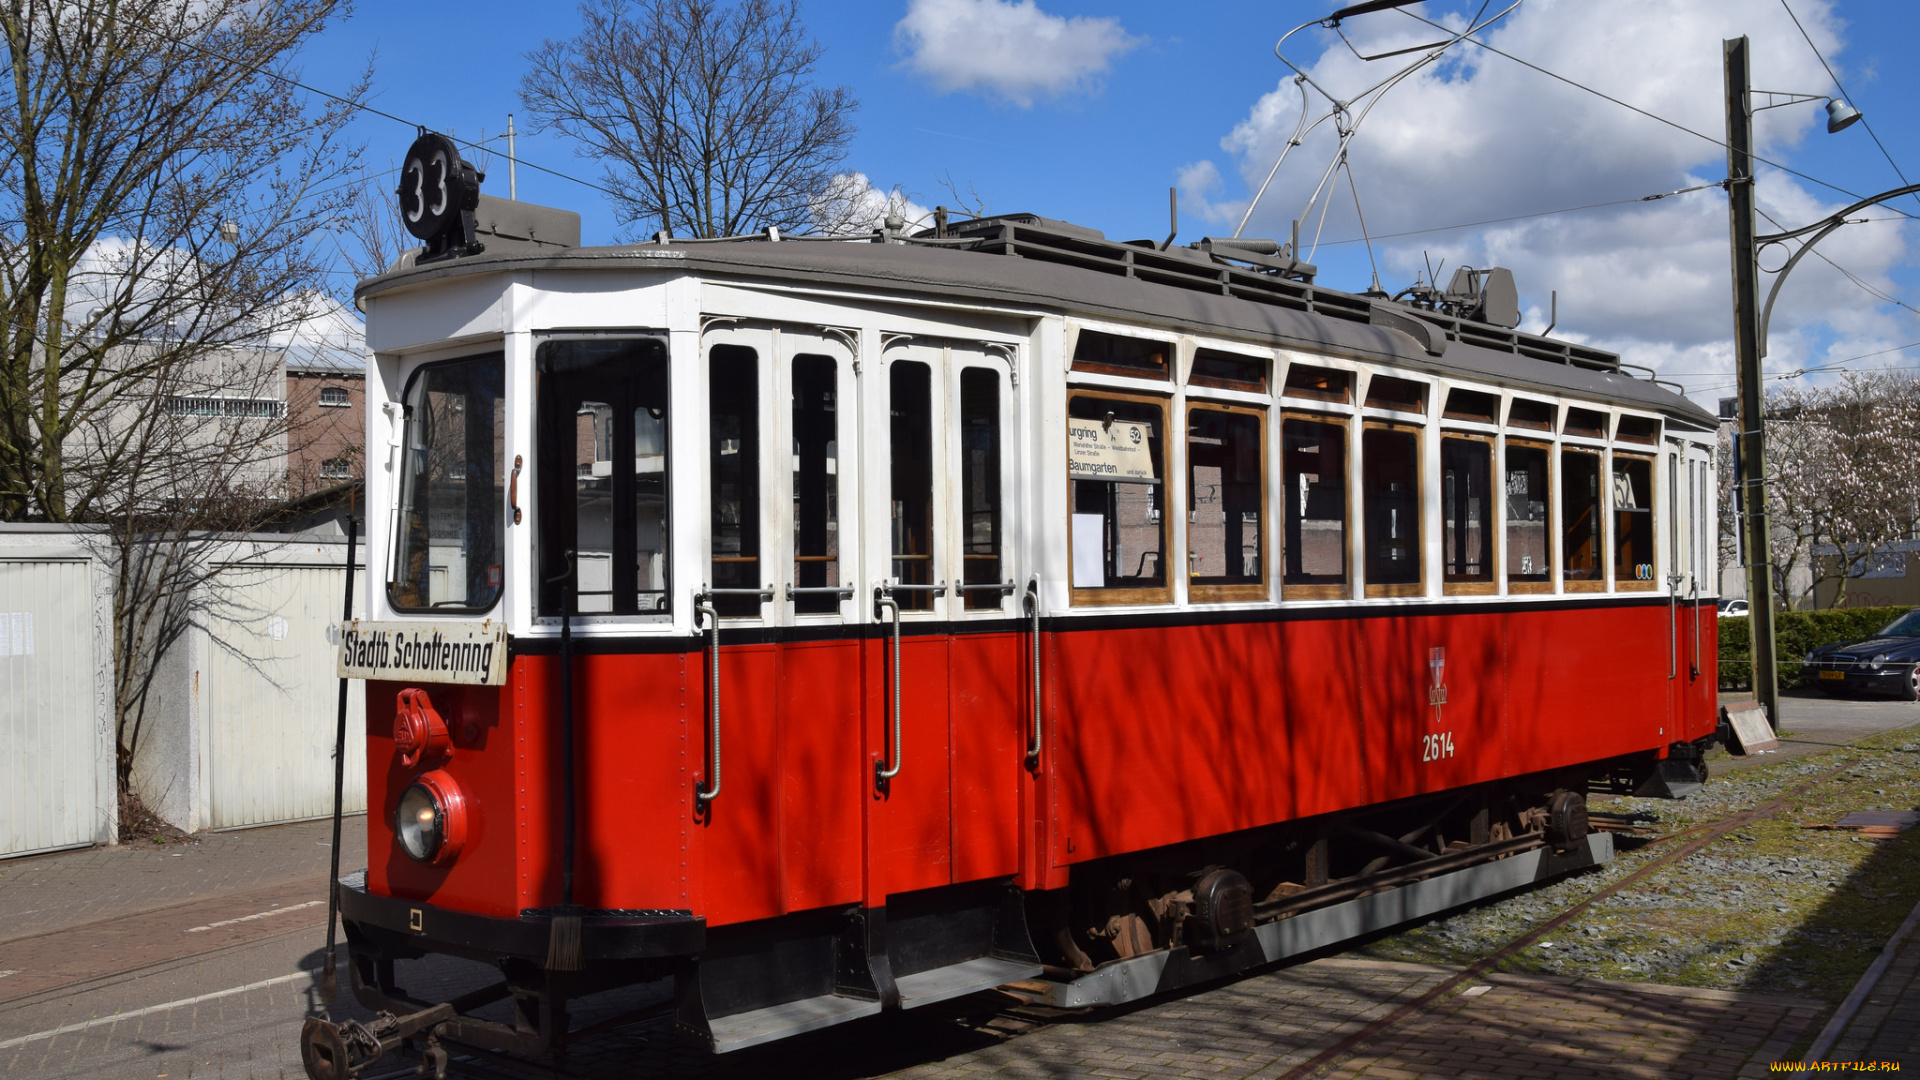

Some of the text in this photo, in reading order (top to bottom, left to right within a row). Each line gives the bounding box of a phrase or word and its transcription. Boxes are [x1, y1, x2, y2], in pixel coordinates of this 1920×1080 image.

[407, 150, 448, 223] 33
[1069, 427, 1098, 442] urgring
[1069, 459, 1118, 475] Baumgarten
[344, 631, 494, 684] Stadtb. Schottenring
[1422, 731, 1455, 762] 2614
